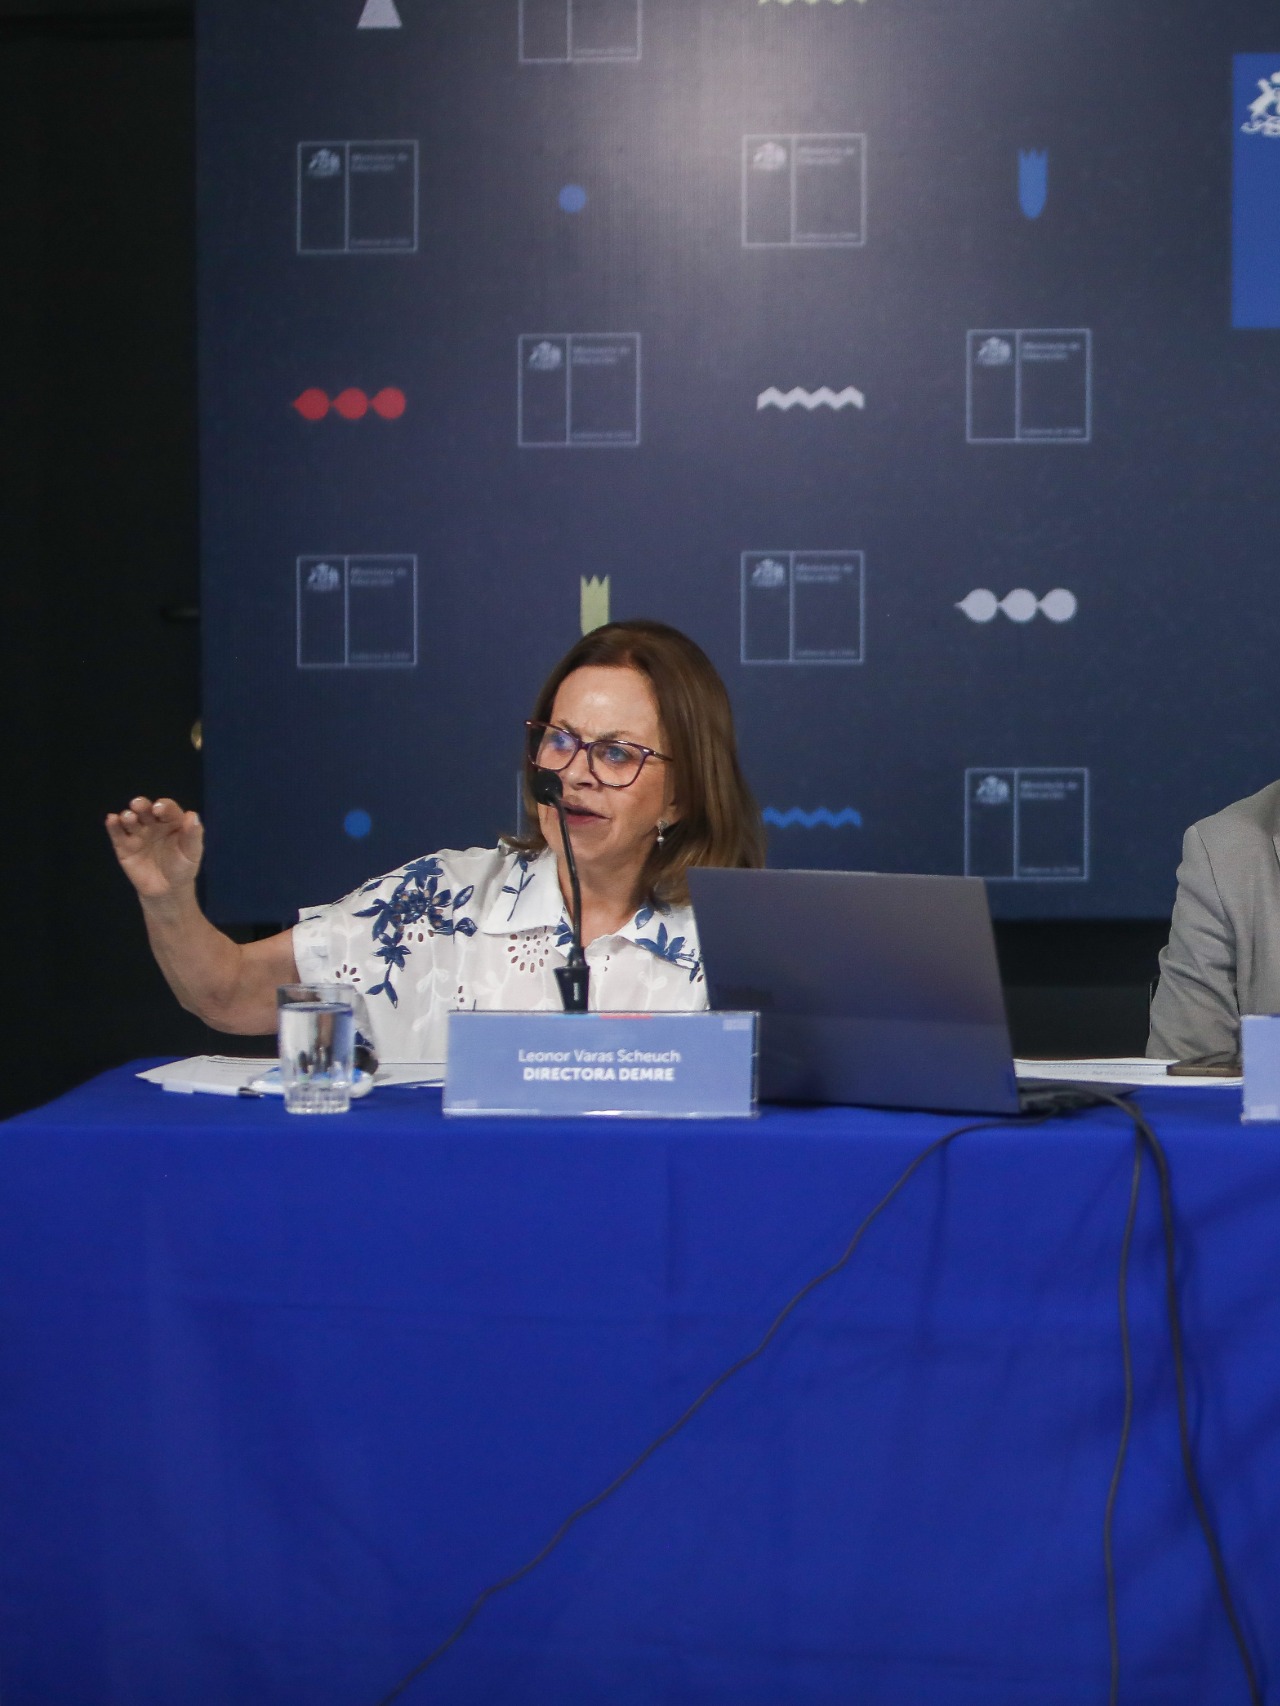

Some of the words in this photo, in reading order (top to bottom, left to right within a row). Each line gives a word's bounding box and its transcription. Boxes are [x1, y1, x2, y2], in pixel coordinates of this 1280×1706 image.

[518, 1049, 571, 1063] Leonor
[573, 1049, 614, 1063] Varas
[617, 1049, 681, 1063] Scheuch
[523, 1067, 616, 1081] DIRECTORA
[618, 1067, 675, 1081] DEMRE
